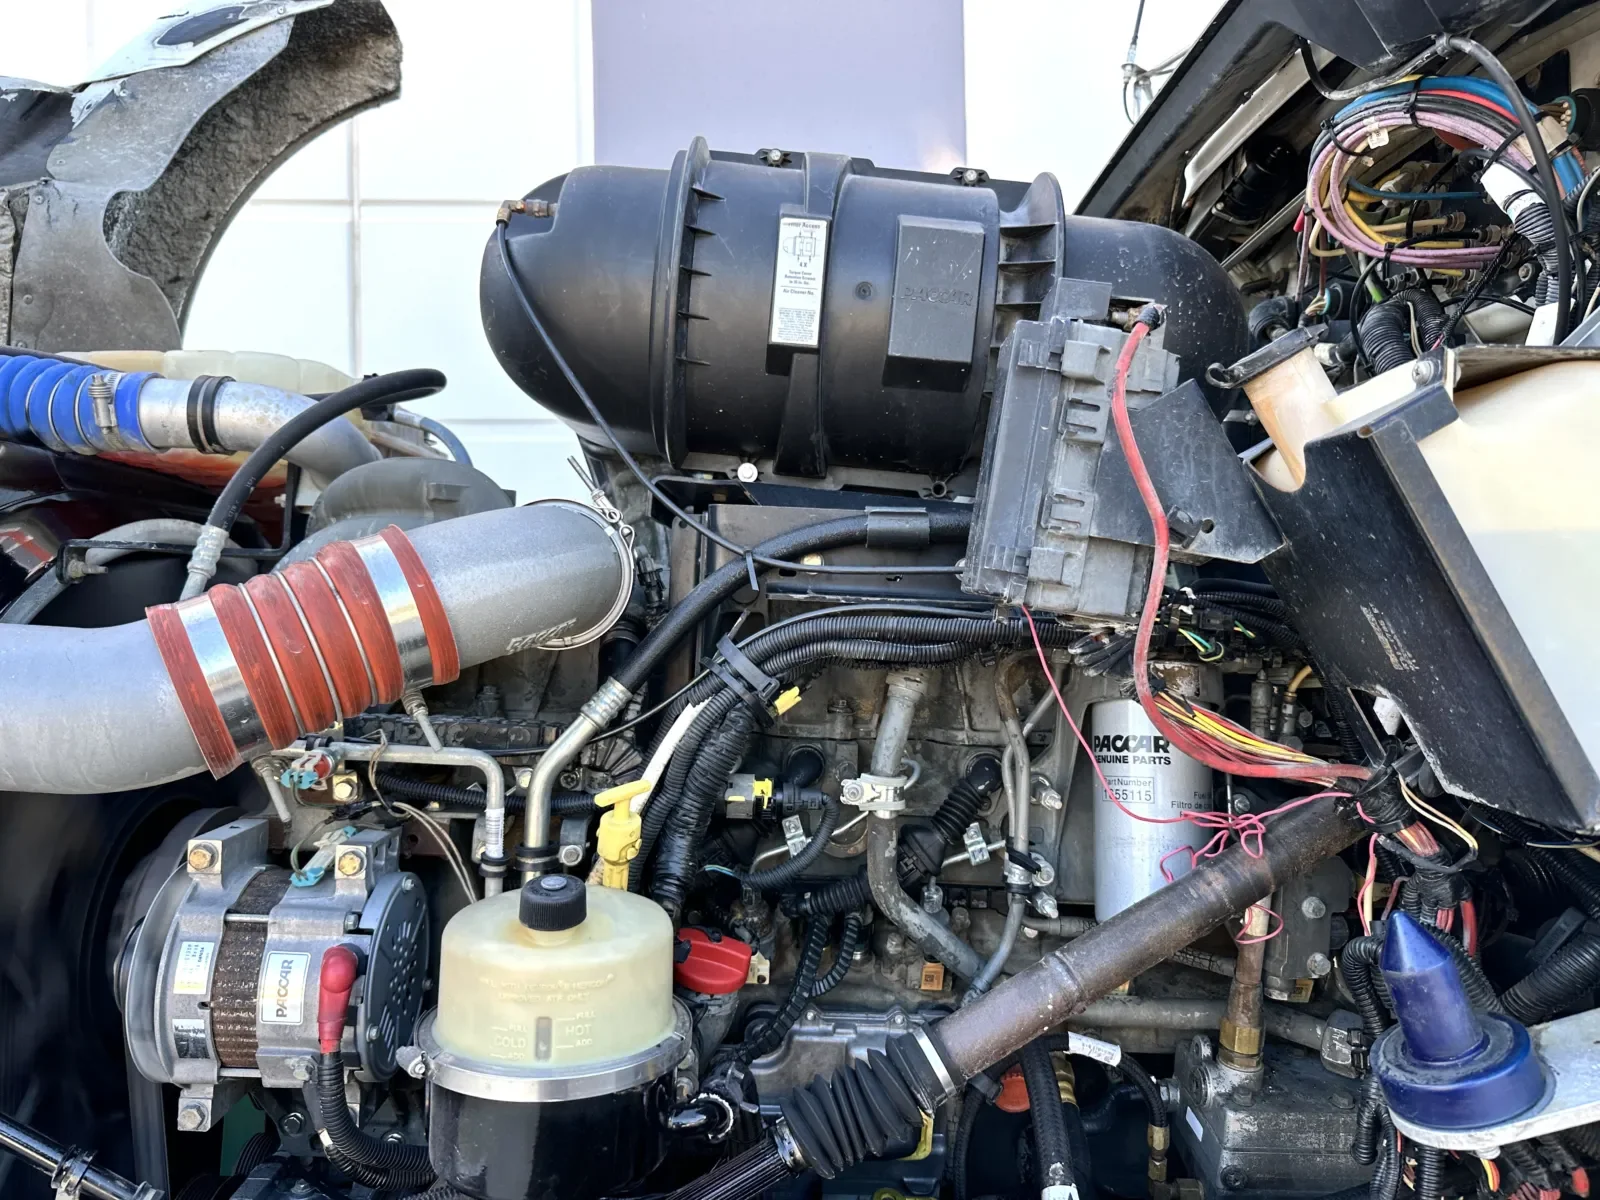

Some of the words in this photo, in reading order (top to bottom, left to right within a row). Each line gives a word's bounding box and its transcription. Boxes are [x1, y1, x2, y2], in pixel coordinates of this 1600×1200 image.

[1094, 734, 1170, 753] PACCAR
[1132, 755, 1172, 766] PARTS
[1170, 800, 1192, 809] Filtro
[1194, 801, 1203, 809] de
[275, 959, 294, 1018] PACCAR
[576, 1011, 597, 1020] FULL
[565, 1024, 592, 1036] HOT
[494, 1036, 526, 1049] COLD
